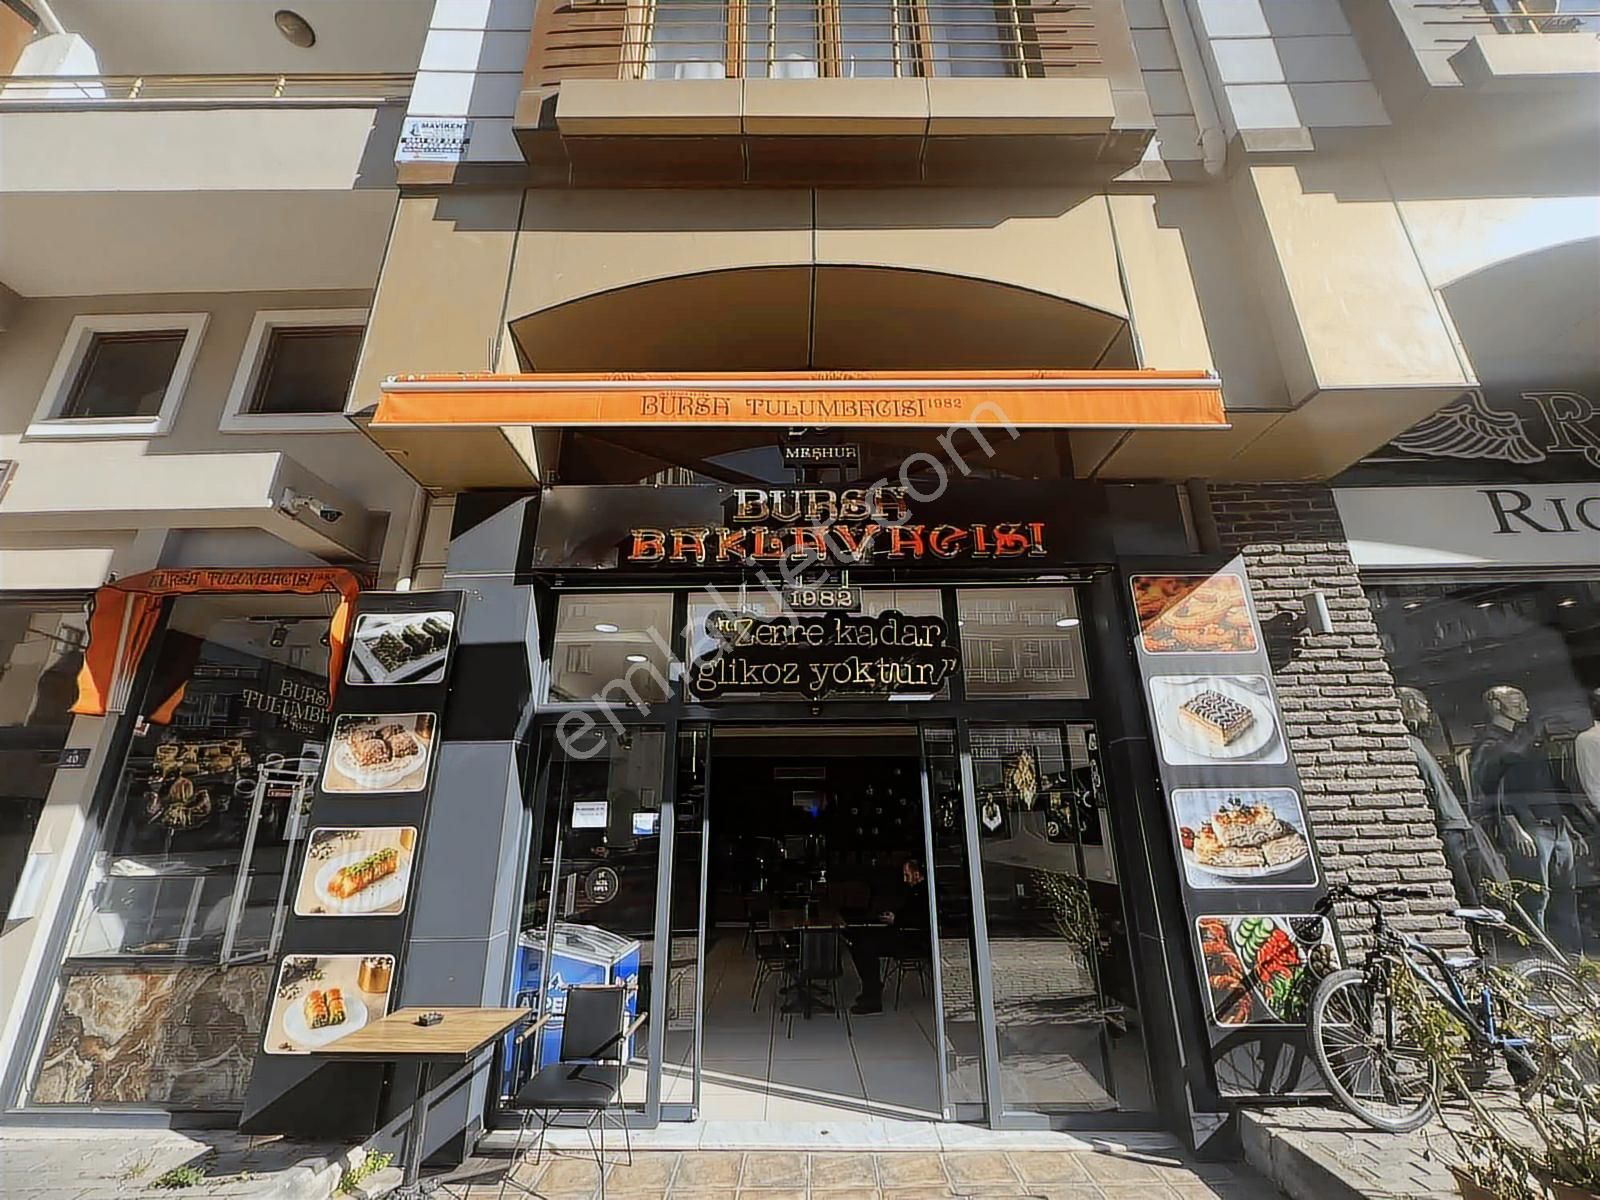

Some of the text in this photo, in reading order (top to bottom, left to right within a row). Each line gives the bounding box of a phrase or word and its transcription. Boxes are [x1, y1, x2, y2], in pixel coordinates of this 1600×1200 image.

[640, 394, 730, 417] BURSA
[927, 398, 963, 409] 1982
[1520, 390, 1600, 469] R
[732, 486, 910, 523] BURSA
[627, 522, 1047, 564] BAKLAVACISI
[789, 590, 852, 607] 1982
[834, 617, 941, 648] kadar
[696, 657, 800, 692] glikoz
